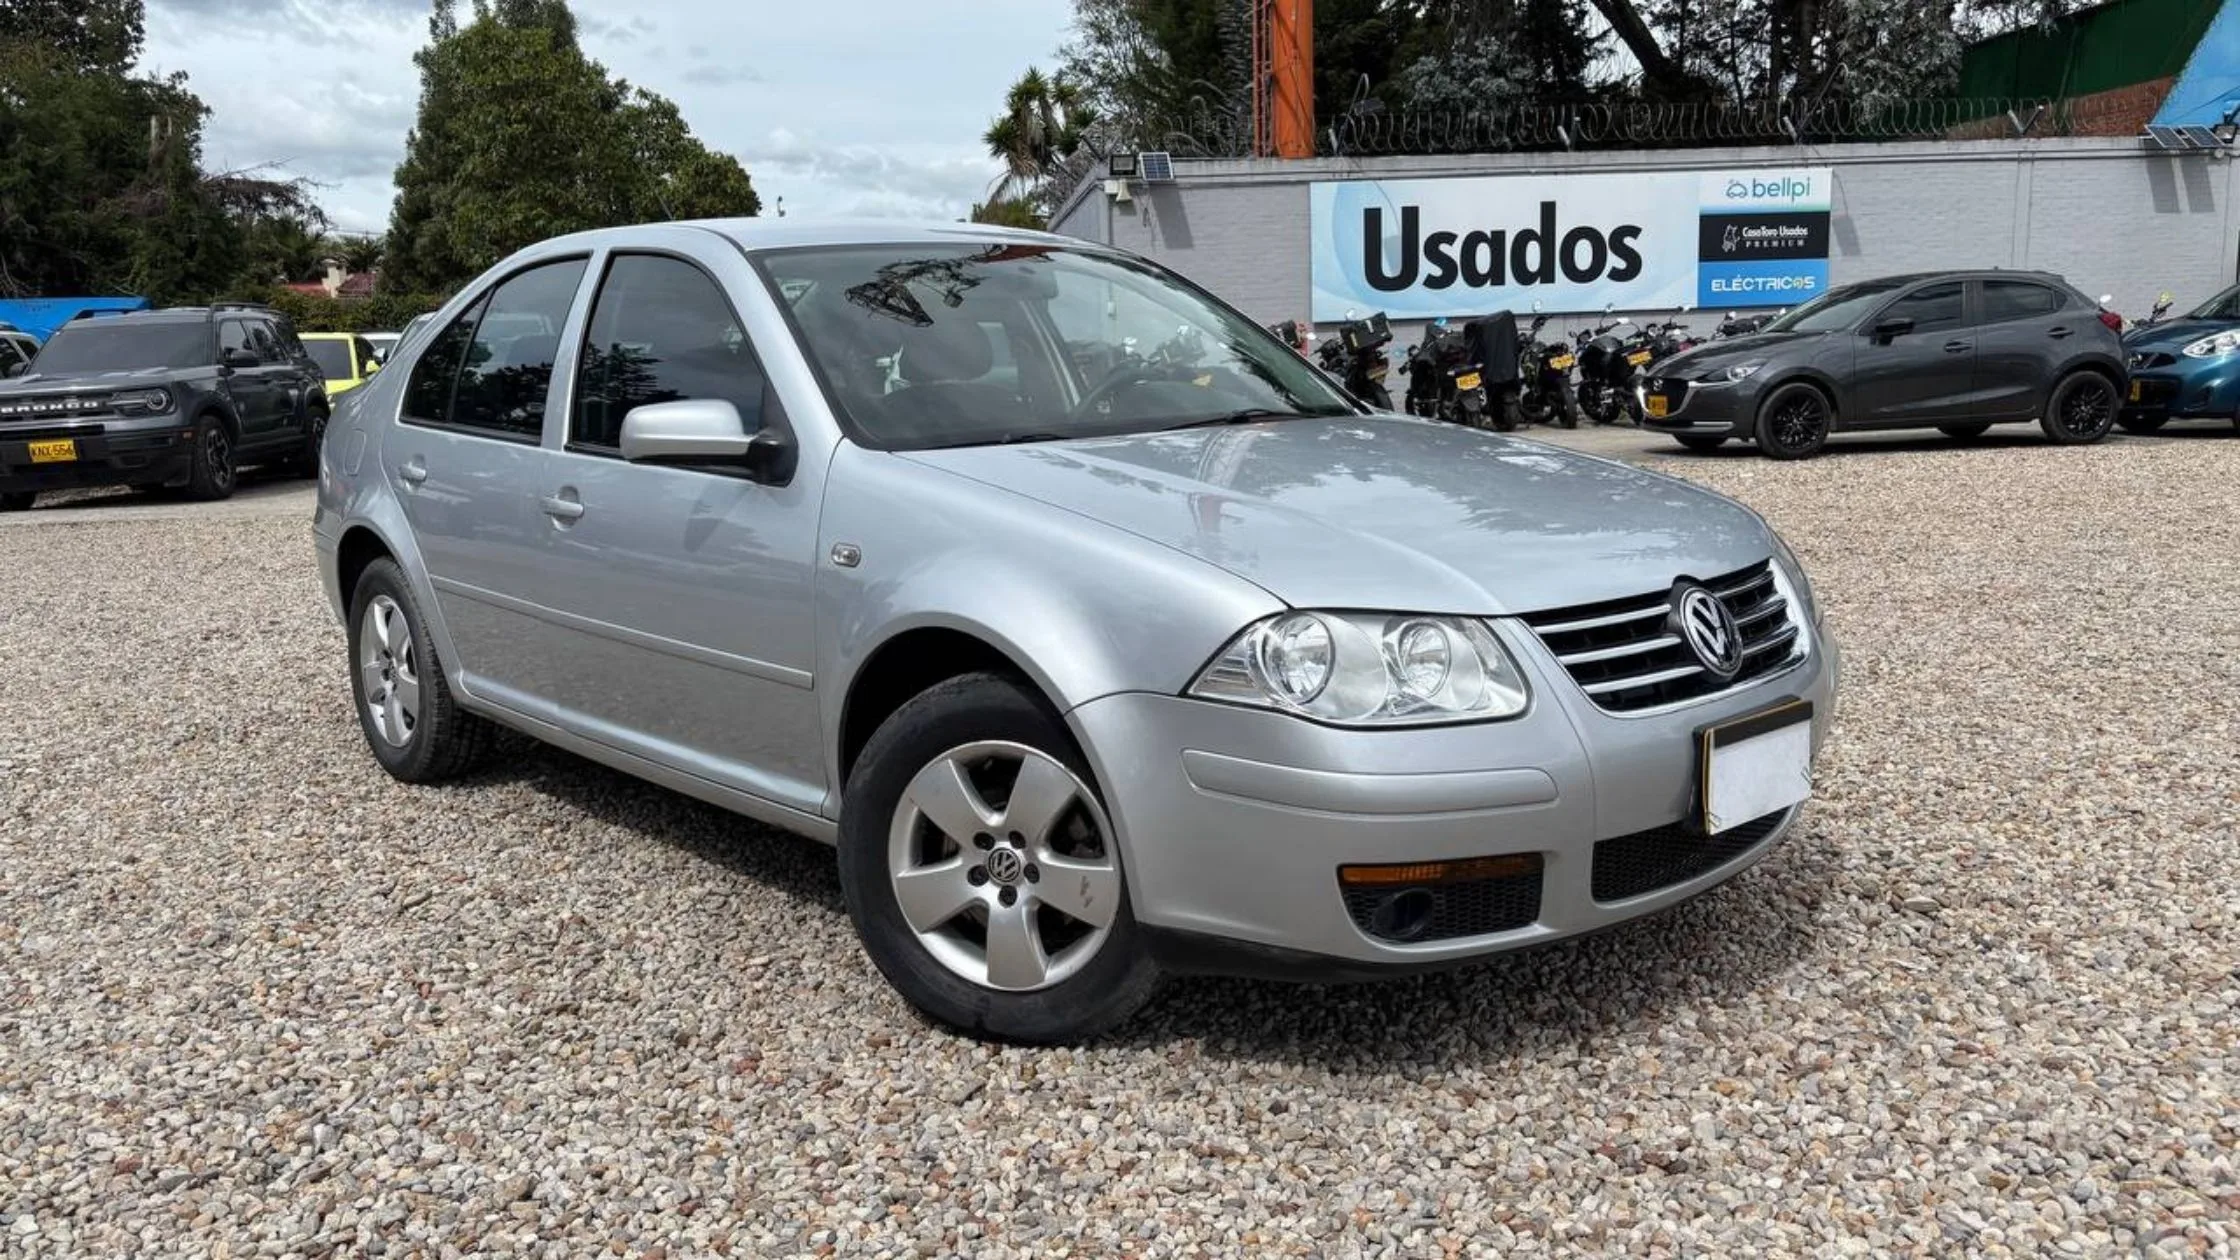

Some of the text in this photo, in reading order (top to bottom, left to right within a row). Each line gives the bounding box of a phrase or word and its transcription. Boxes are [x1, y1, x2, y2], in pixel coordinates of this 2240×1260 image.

[1752, 177, 1811, 202] bellpi
[1779, 225, 1808, 237] Usados
[1363, 201, 1642, 292] Usados
[1745, 239, 1805, 248] PREMIUM
[1, 401, 98, 413] BRONCO
